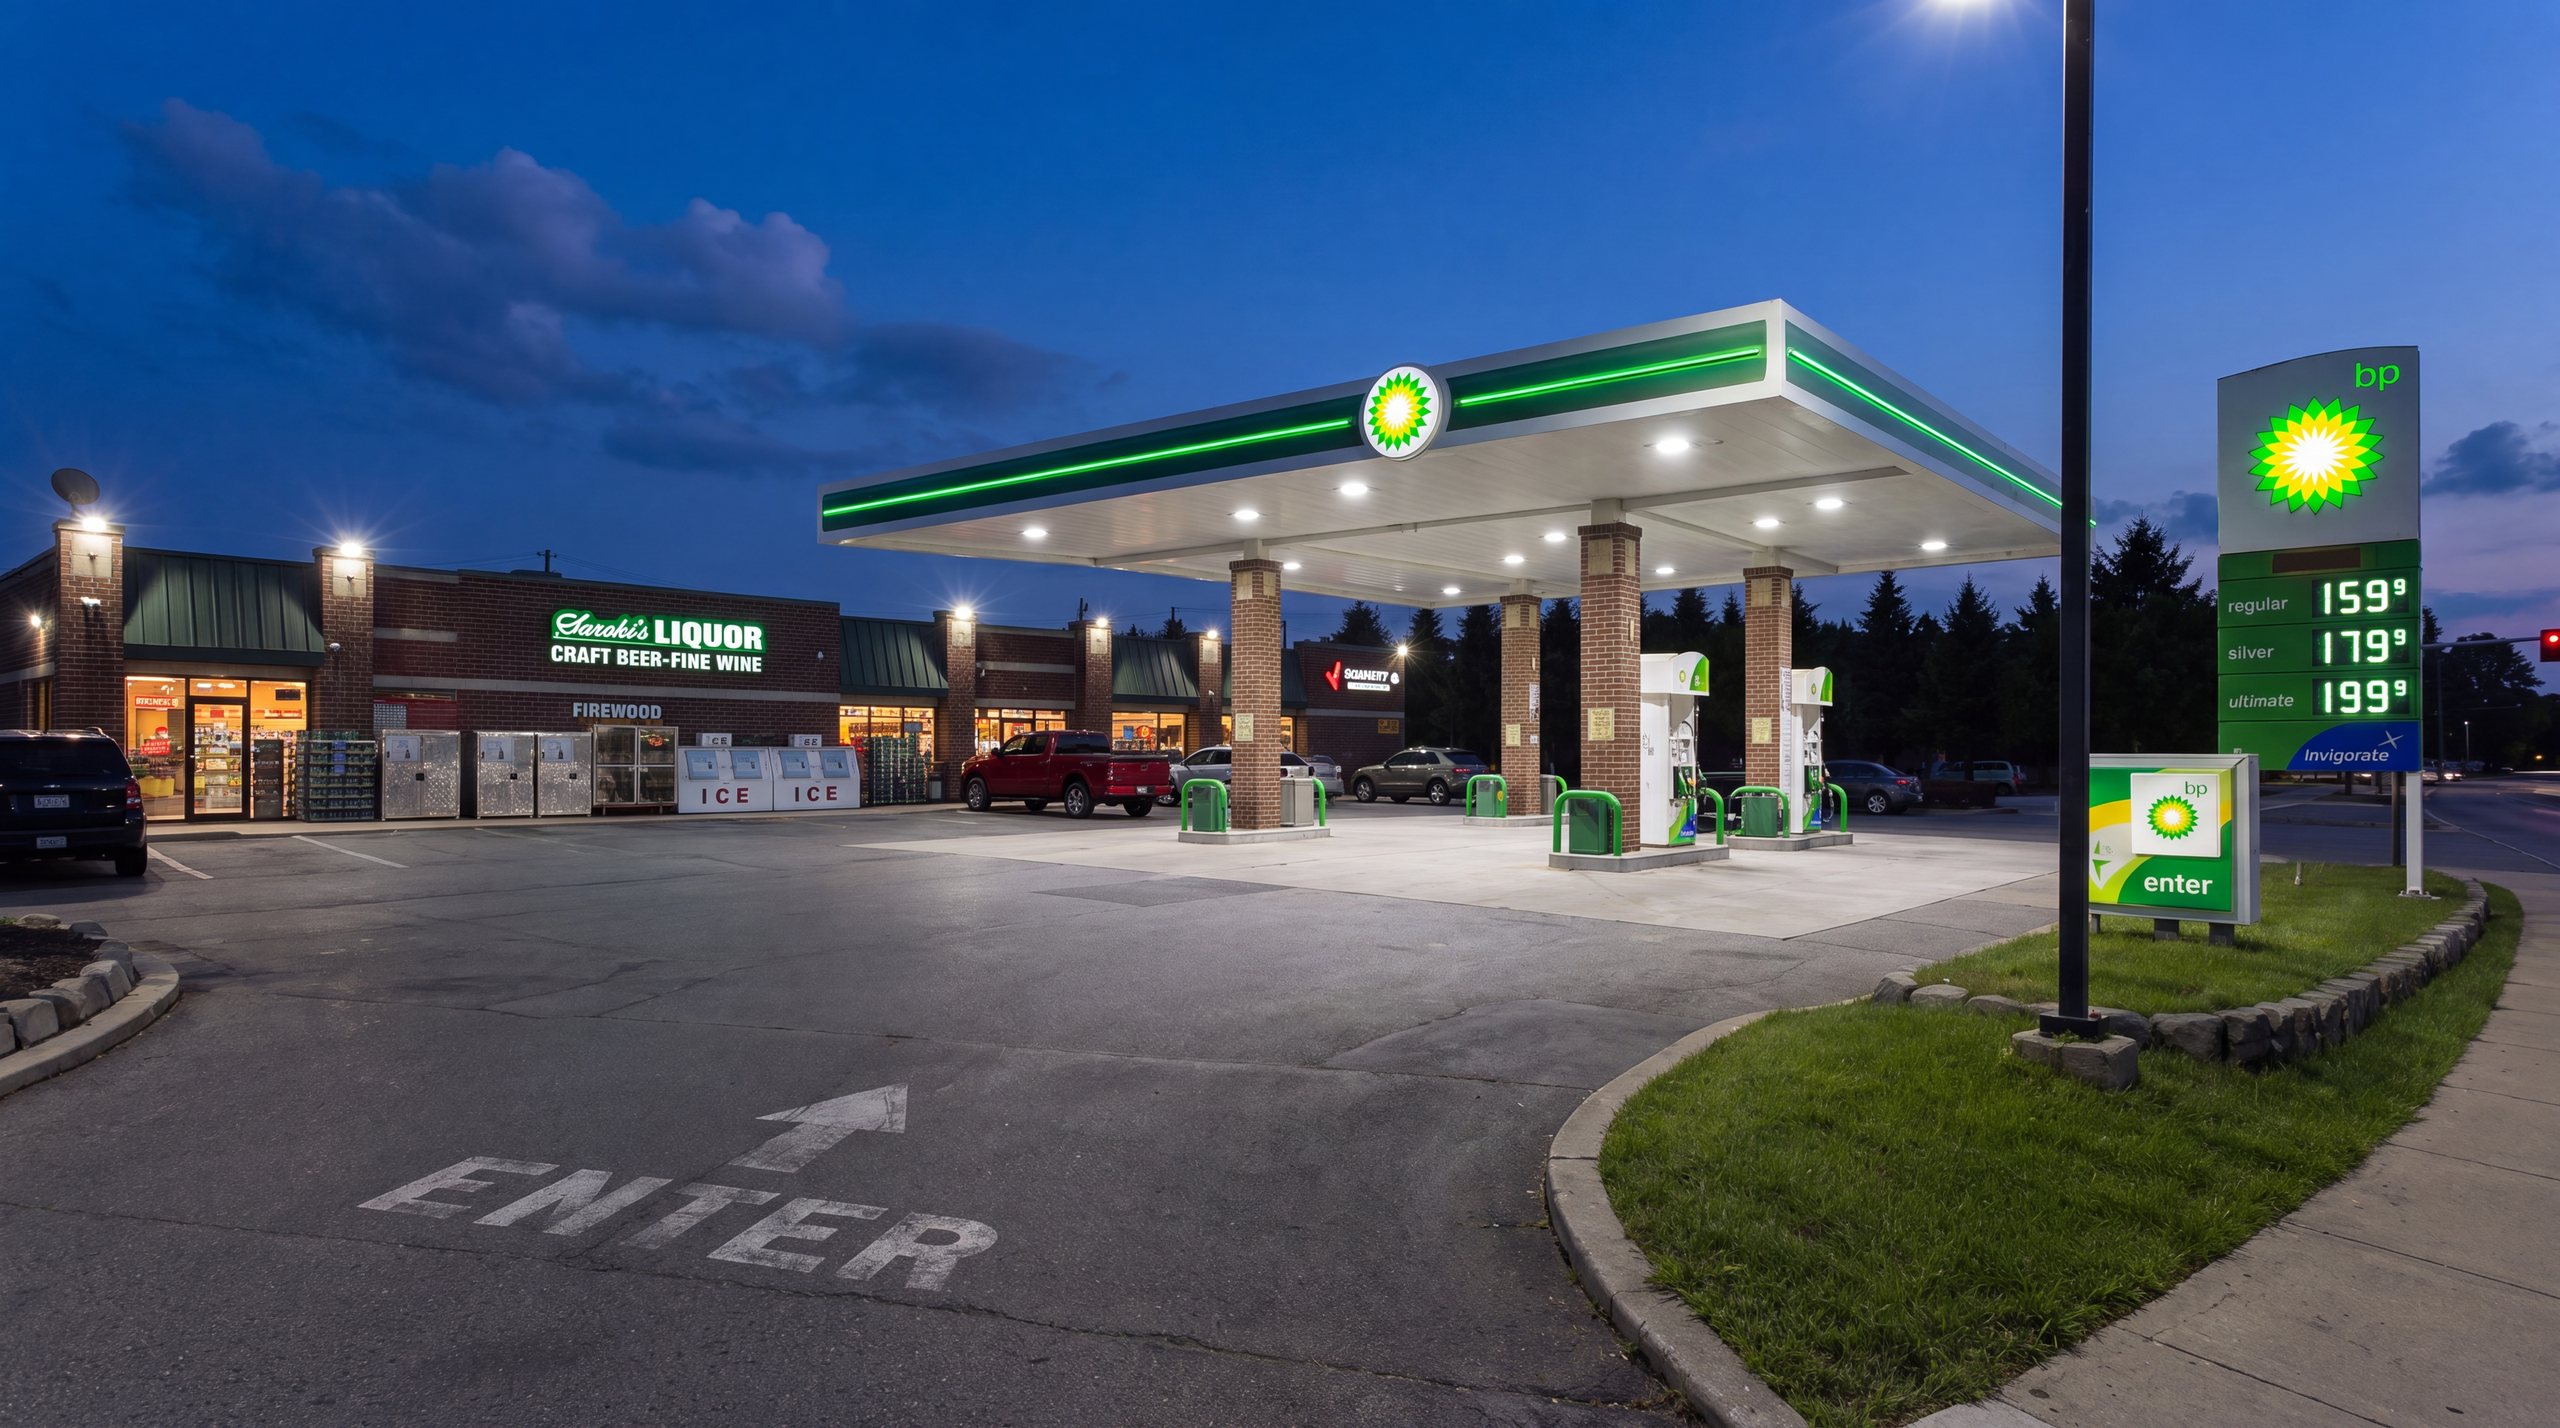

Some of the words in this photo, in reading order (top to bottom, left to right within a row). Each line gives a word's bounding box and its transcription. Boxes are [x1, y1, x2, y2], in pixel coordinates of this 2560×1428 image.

[2355, 362, 2400, 391] bp
[2228, 597, 2288, 615] regular
[554, 613, 649, 640] Saroki's
[654, 619, 763, 650] LIQUOR
[551, 645, 611, 664] CRAFT
[716, 654, 762, 672] WINE
[2228, 646, 2274, 660] silver
[2229, 693, 2294, 709] ultimate
[573, 702, 662, 719] FIREWOOD
[2304, 748, 2389, 765] Invigorate
[701, 787, 749, 804] ICE
[794, 785, 838, 802] ICE
[2185, 781, 2208, 798] bp
[2143, 874, 2213, 895] enter
[357, 1155, 999, 1292] ENTER
